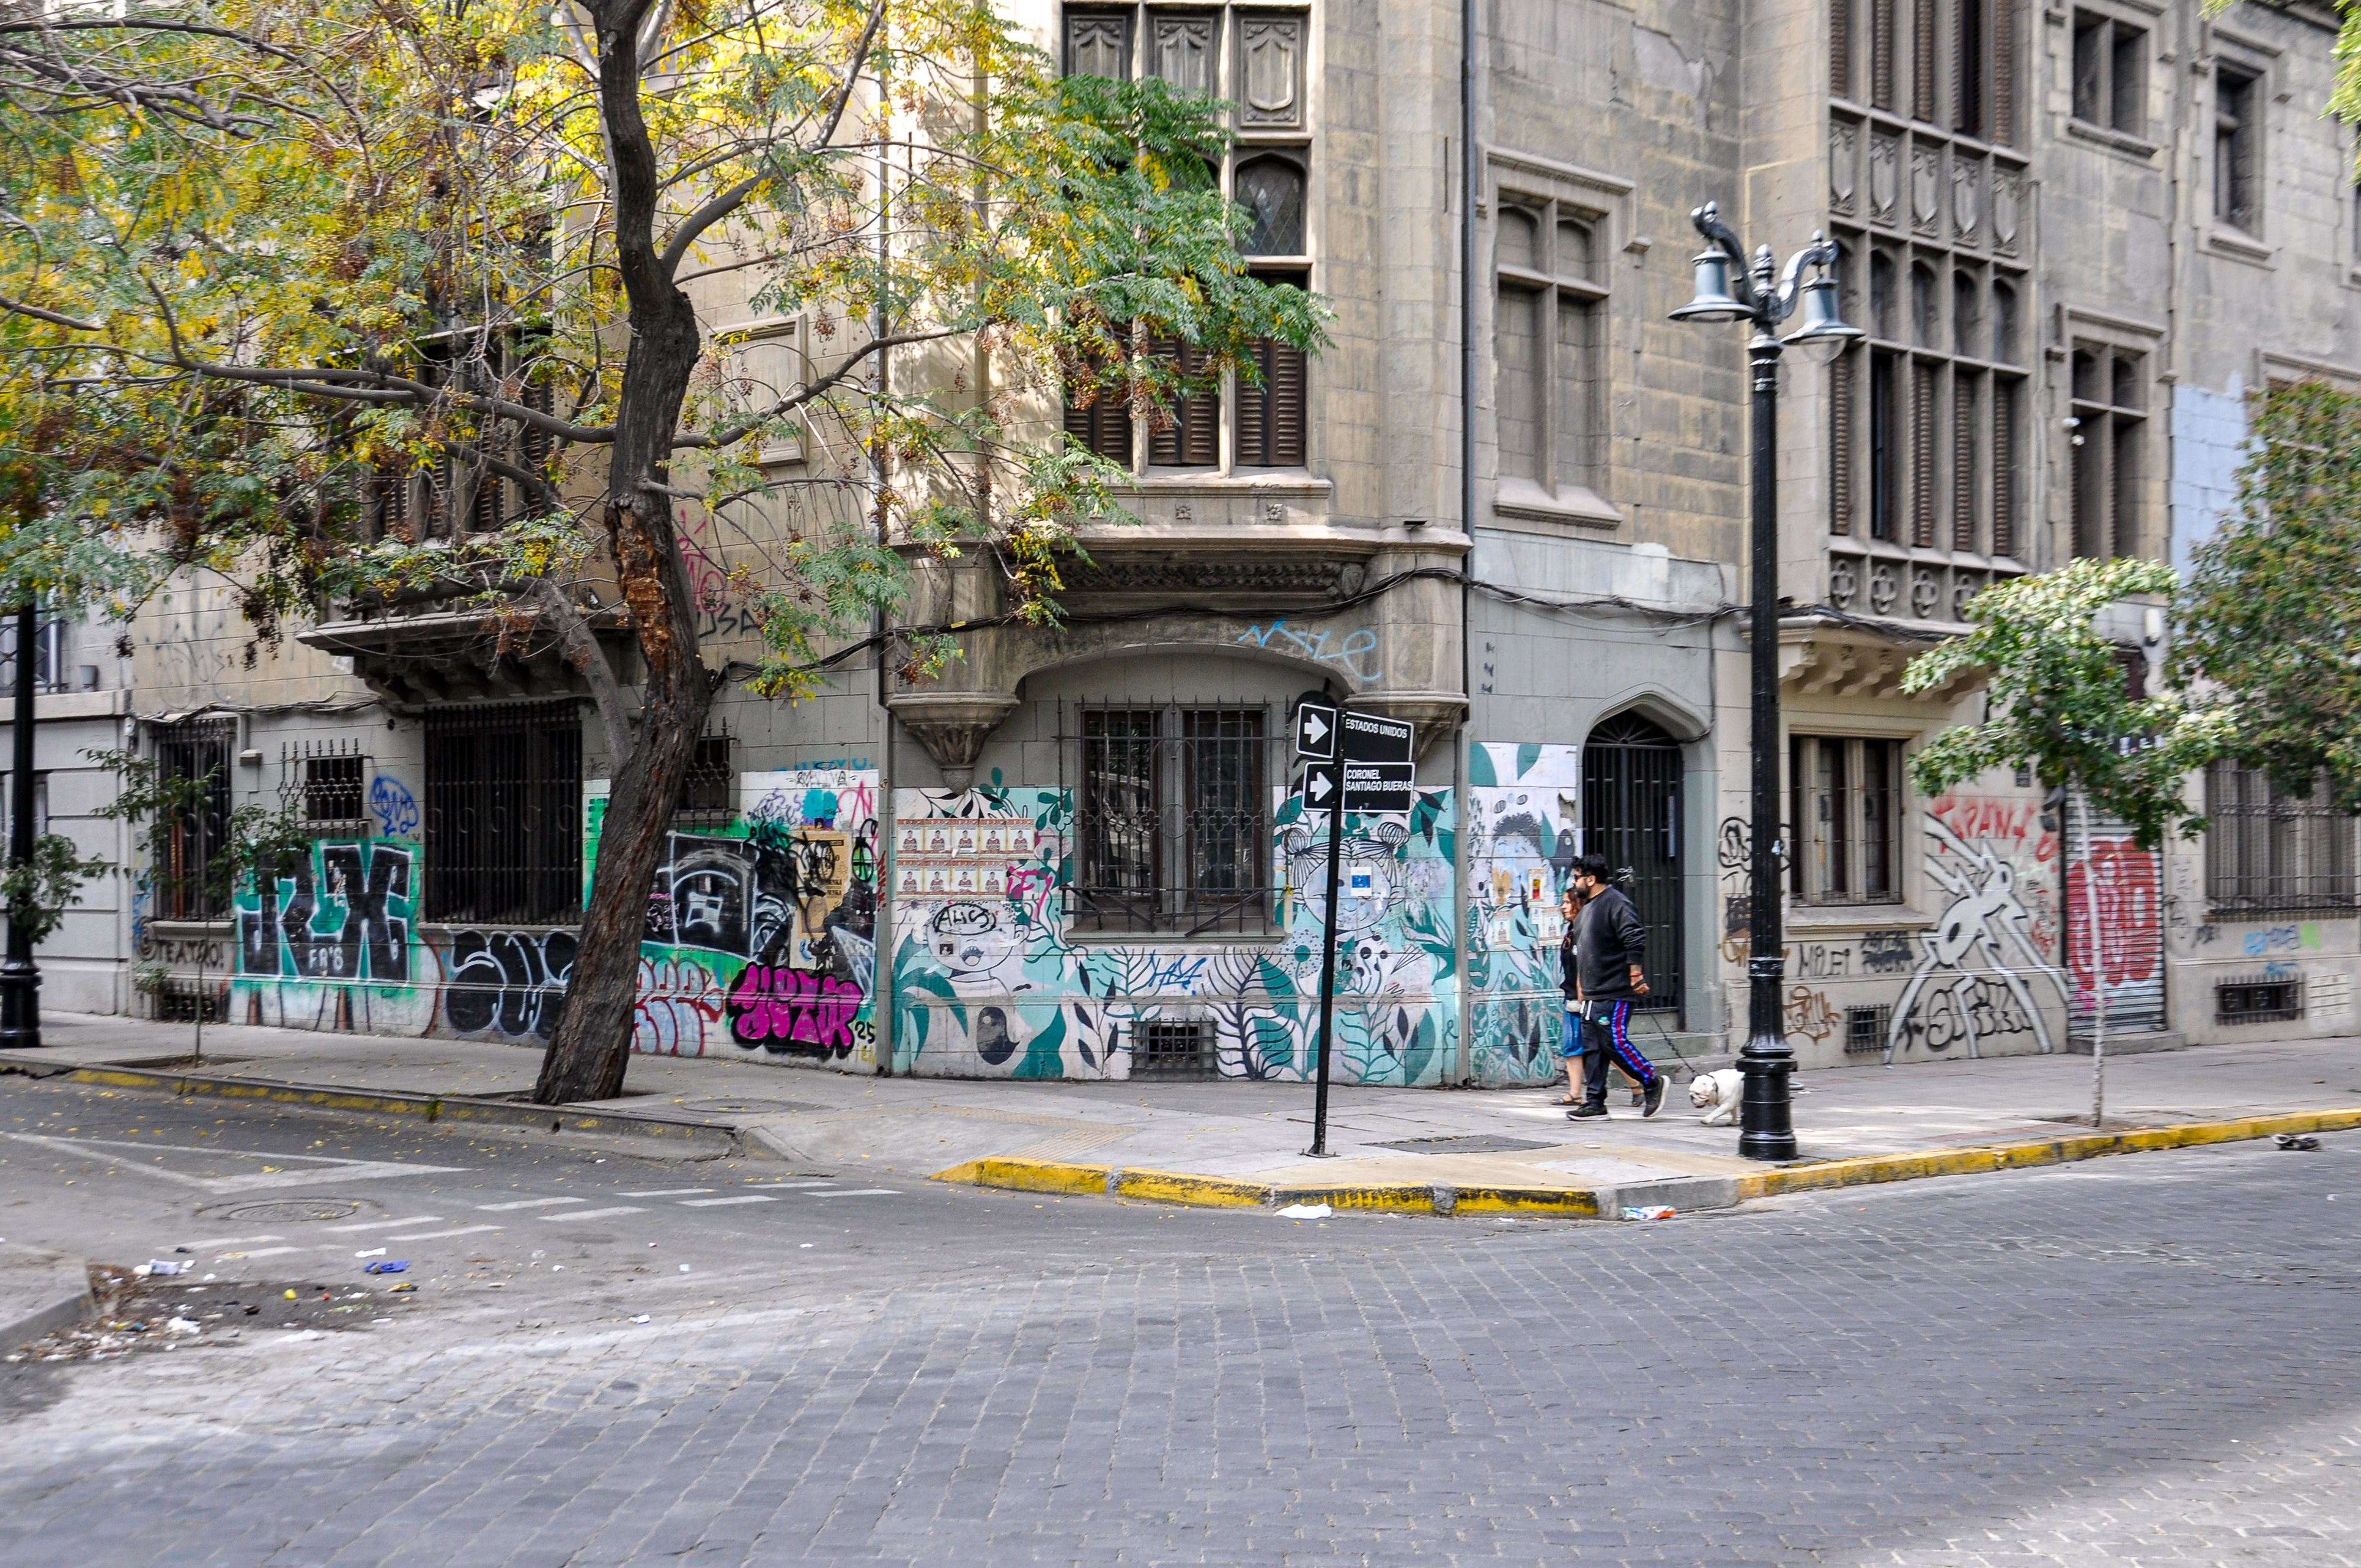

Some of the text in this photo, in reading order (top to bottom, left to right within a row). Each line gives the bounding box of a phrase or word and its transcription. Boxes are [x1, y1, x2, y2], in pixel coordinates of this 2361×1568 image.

[1345, 718, 1408, 739] ESTADOS UNIDOS
[1346, 769, 1381, 780] CORONEL
[1346, 781, 1412, 791] SANTIAGO BUERAS
[855, 1021, 876, 1044] 25
